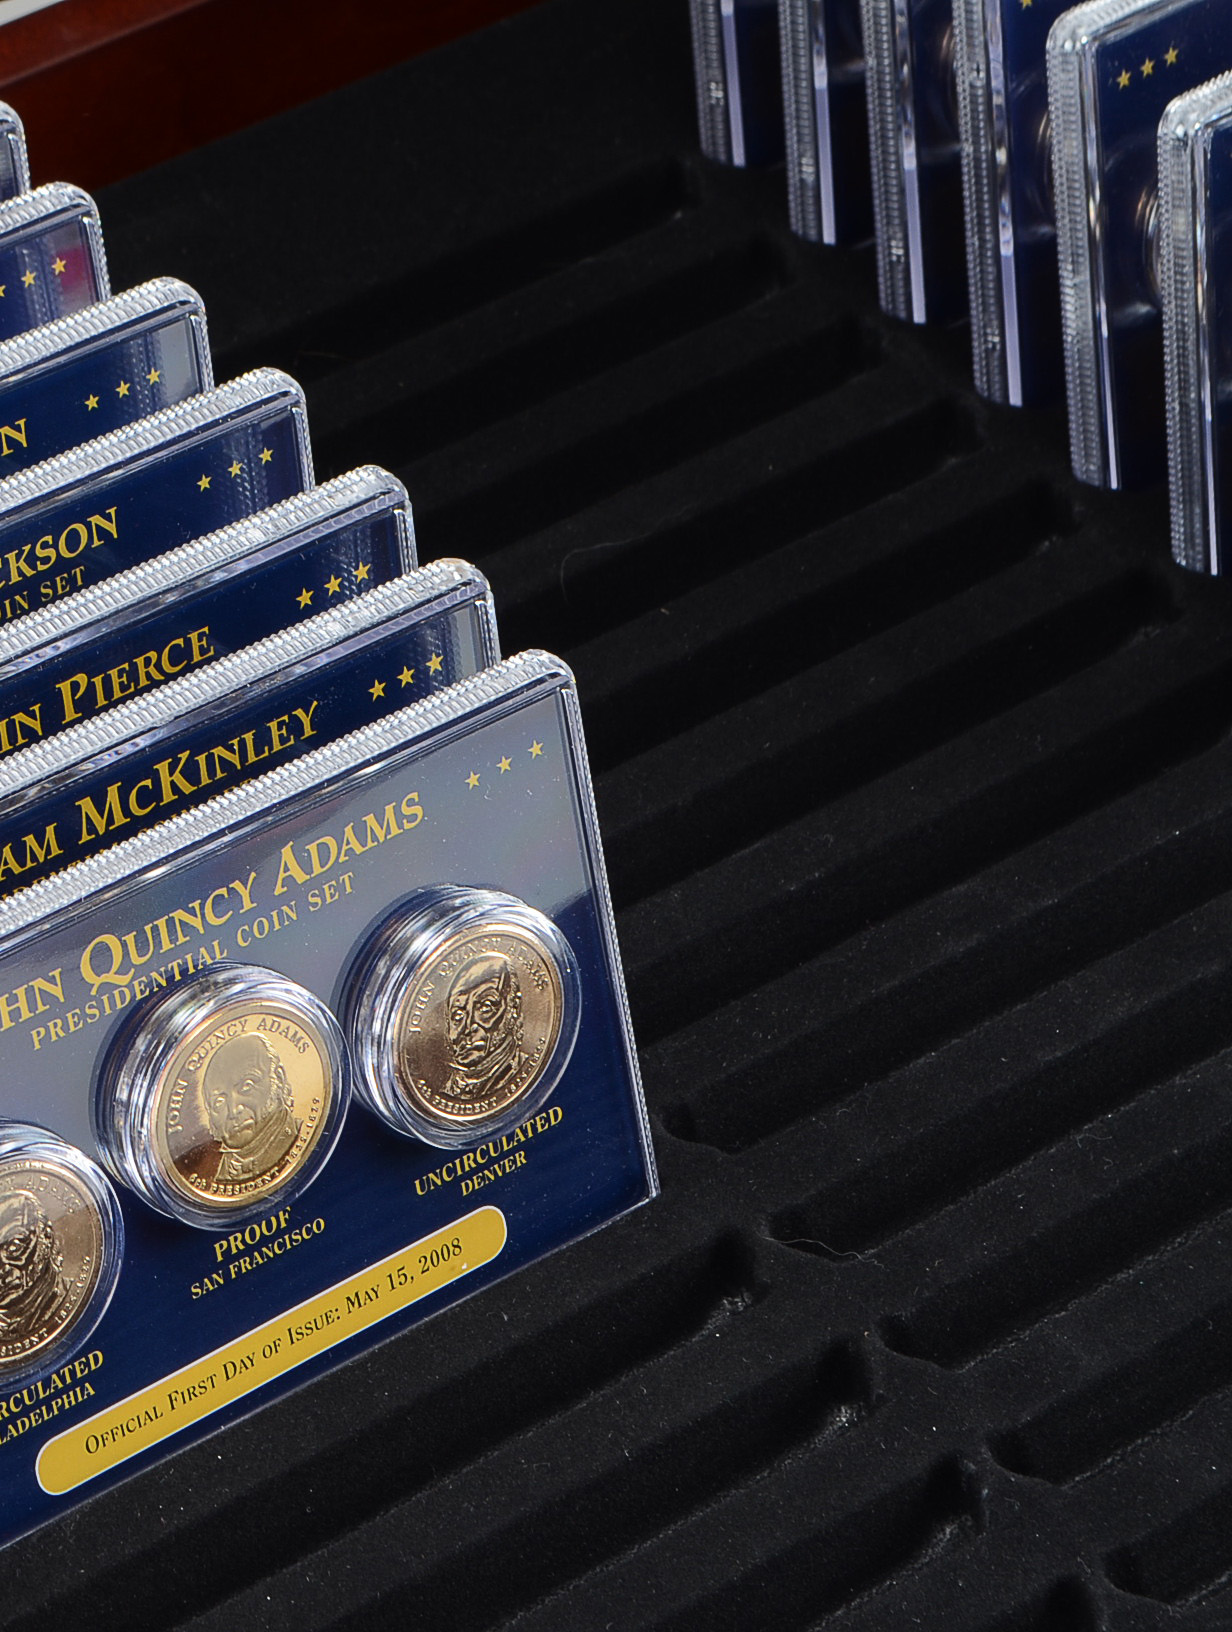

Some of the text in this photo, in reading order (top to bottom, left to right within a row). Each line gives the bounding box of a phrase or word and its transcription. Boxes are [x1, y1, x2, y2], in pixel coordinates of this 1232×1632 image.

[40, 566, 86, 602] SET
[56, 626, 215, 724] PIERCE
[75, 700, 319, 844] MCKINLEY
[80, 871, 256, 996] QUINCY
[274, 792, 424, 896] ADAMS
[30, 871, 356, 1051] PRESIDENTIAL COIN SET
[167, 1017, 310, 1134] JOHN QUINCY ADAMS
[210, 1166, 280, 1196] PRESIDENT
[414, 1106, 564, 1197] UNCIRCULATED
[460, 1150, 528, 1197] DENVER
[190, 1217, 326, 1300] SAN FRANCISCO
[214, 1206, 294, 1263] PROOF
[84, 1236, 464, 1456] OFFICIAL FIRST DAY OF ISSUE: MAY 15, 2008
